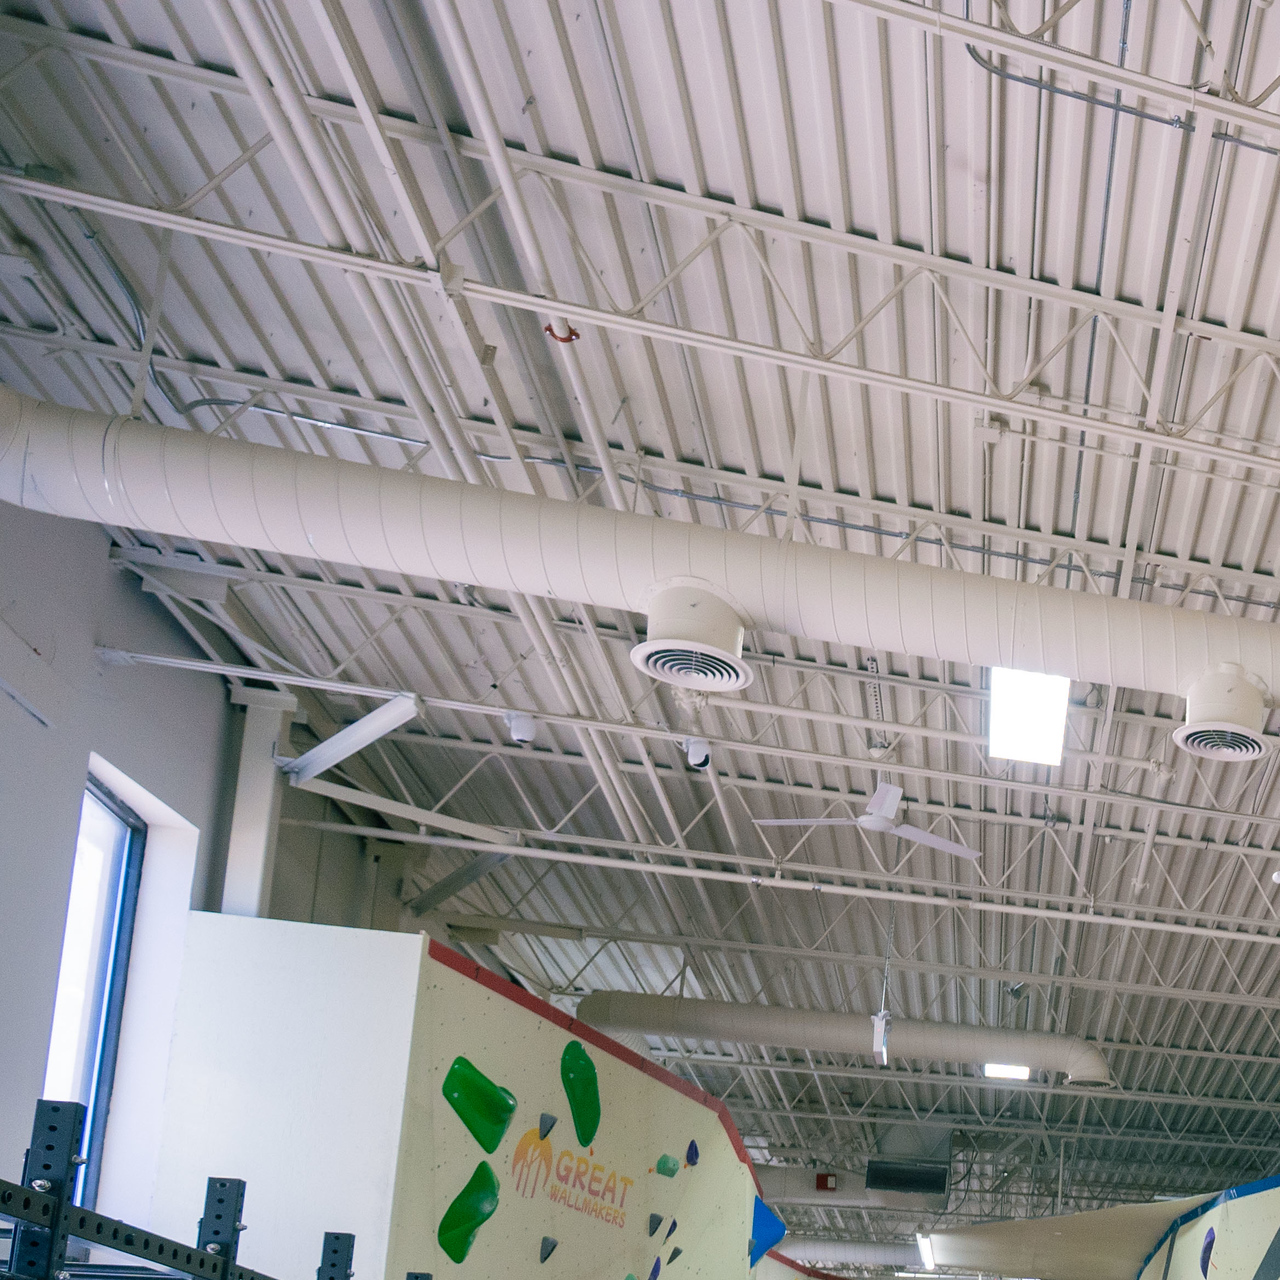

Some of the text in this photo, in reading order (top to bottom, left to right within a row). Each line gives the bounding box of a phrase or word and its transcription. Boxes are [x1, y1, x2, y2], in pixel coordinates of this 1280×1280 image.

[556, 1149, 634, 1208] GREAT
[1230, 1188, 1238, 1198] 11
[549, 1183, 627, 1229] WALLMAKERS
